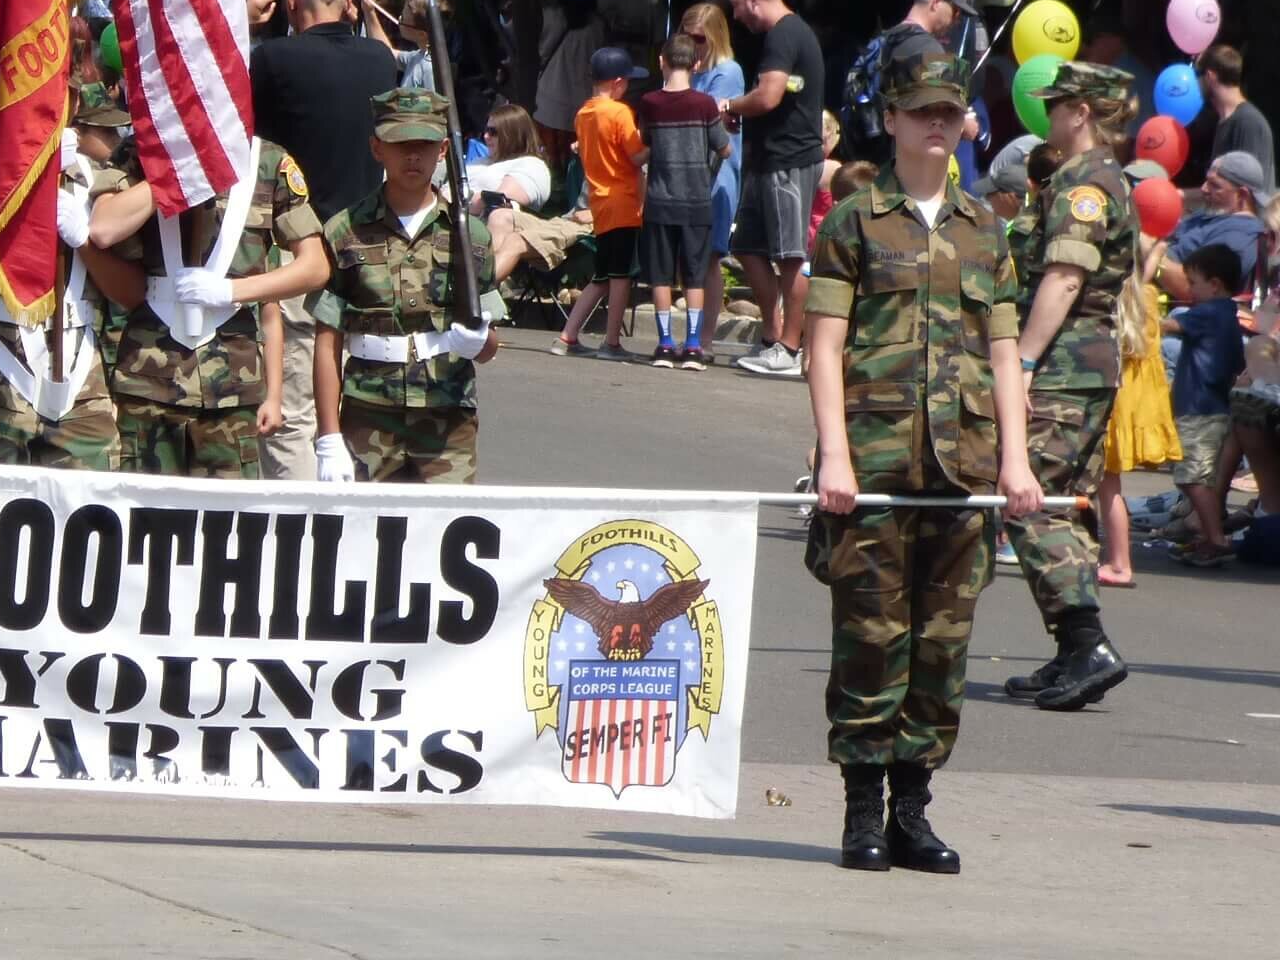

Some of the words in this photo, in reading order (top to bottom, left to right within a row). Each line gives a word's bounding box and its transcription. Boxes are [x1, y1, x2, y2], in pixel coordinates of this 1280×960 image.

[0, 0, 68, 96] FOOT
[580, 528, 679, 554] FOOTHILLS
[533, 609, 545, 697] YOUNG
[571, 667, 589, 678] OF
[593, 667, 617, 678] THE
[622, 667, 676, 678] MARINE
[702, 607, 716, 710] MARINES
[573, 683, 616, 695] CORPS
[620, 683, 673, 695] LEAGUE
[565, 718, 645, 762] SEMPER
[652, 712, 673, 745] FI
